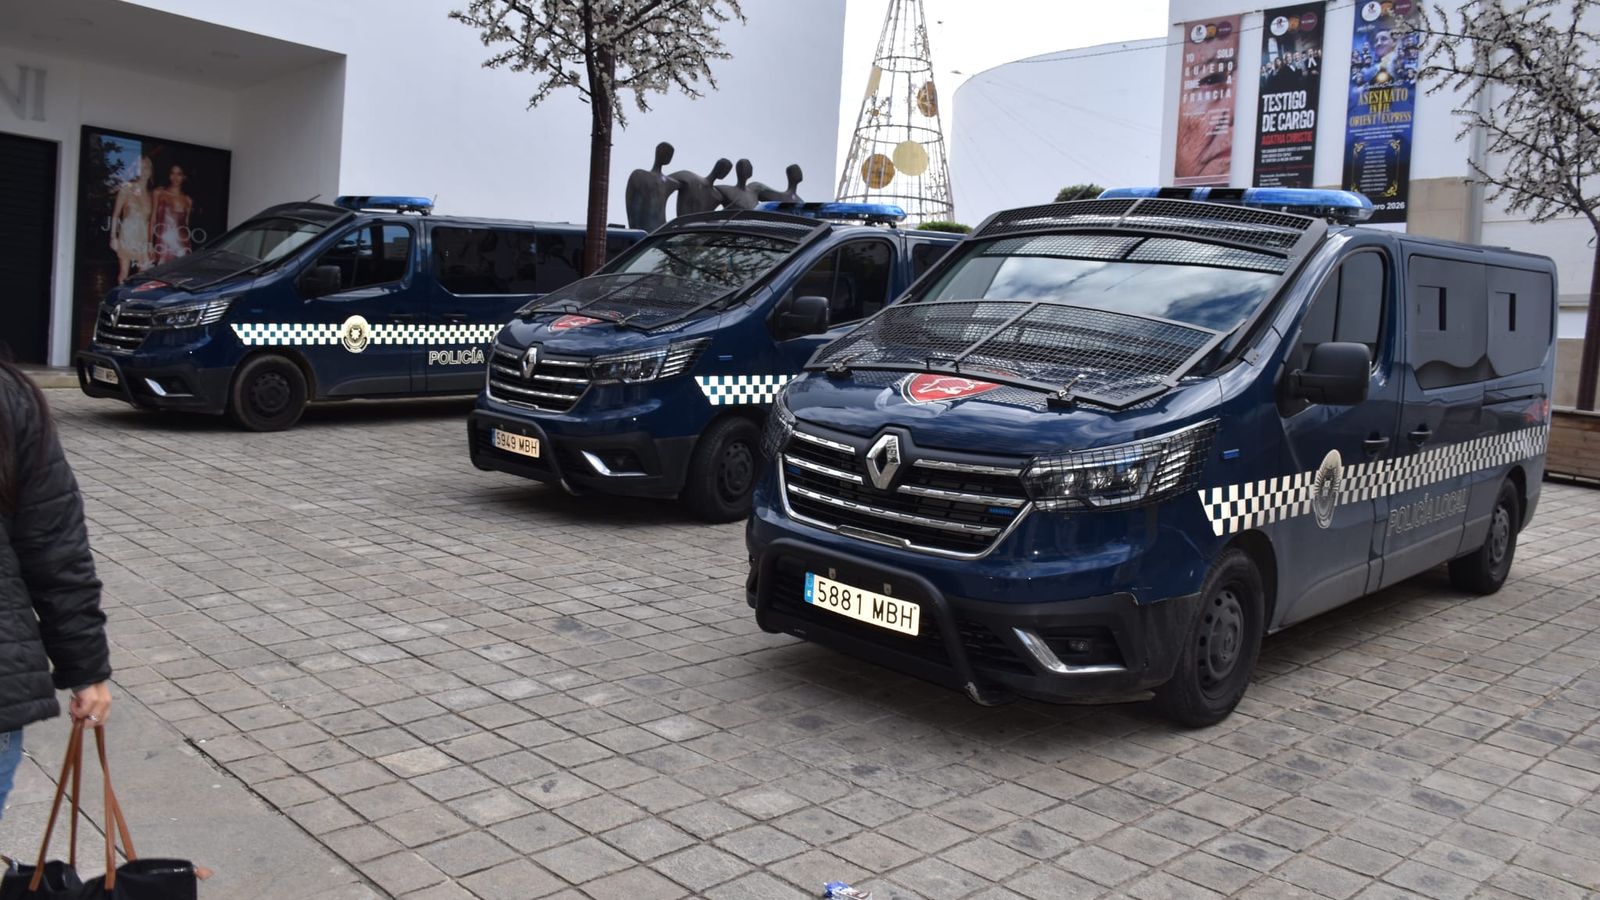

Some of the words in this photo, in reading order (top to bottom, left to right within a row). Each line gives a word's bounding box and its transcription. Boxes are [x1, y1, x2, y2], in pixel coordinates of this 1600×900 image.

[1216, 47, 1234, 60] SOLO
[1184, 60, 1234, 77] QUIERO
[1226, 75, 1233, 85] A
[1183, 88, 1232, 104] FRANCIA
[1261, 90, 1307, 113] TESTIGO
[1358, 87, 1409, 105] ASESINATO
[1261, 113, 1277, 133] DE
[1277, 109, 1315, 131] CARGO
[1381, 111, 1412, 124] EXPRESS
[1386, 201, 1405, 210] 2026
[428, 346, 485, 365] POLICÍA
[496, 431, 517, 450] 5949
[519, 438, 537, 454] MBH
[1387, 492, 1433, 536] POLICÍA
[1434, 487, 1466, 520] LOCAL
[818, 580, 862, 615] 5881
[873, 597, 913, 629] MBH
